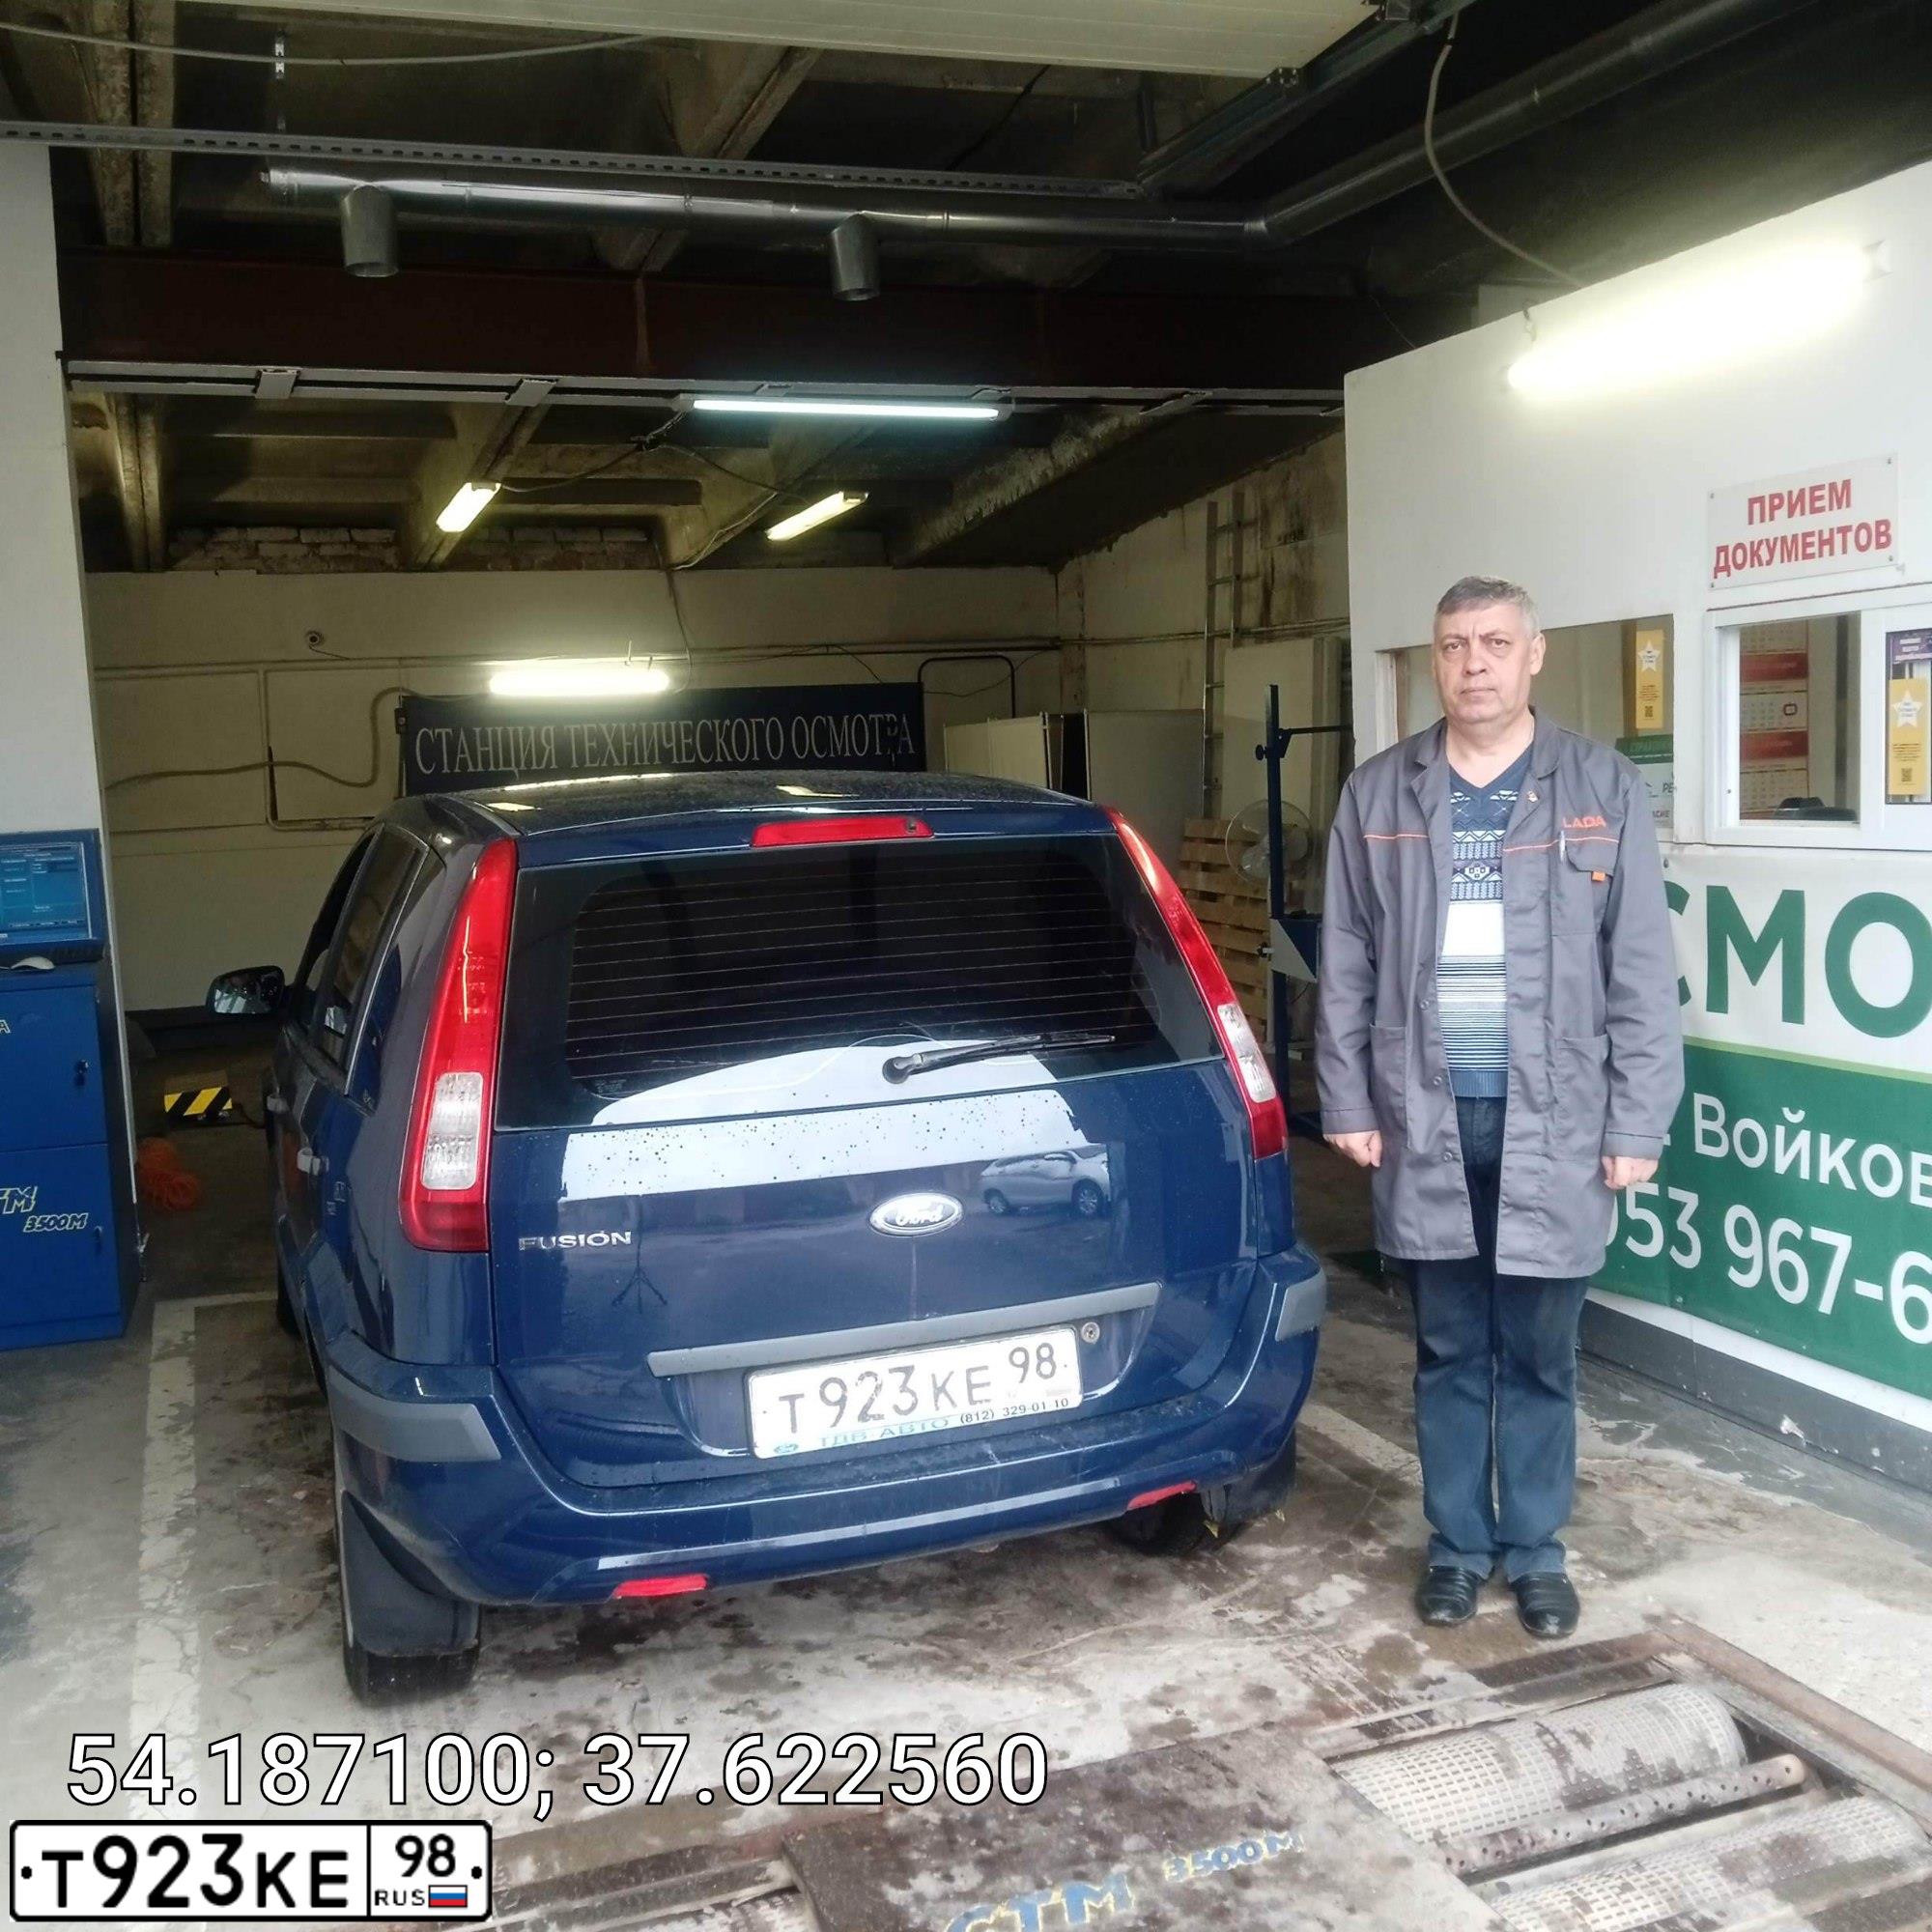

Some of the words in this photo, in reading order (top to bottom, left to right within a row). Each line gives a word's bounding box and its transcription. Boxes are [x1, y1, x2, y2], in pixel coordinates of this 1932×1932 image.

[1747, 478, 1852, 526] ПРИЕМ
[1713, 518, 1892, 580] ДОКУМЕНТОВ
[414, 725, 558, 779] СТАНЦИЯ
[564, 717, 784, 768] ТЕХНИЧЕСКОГО
[1562, 815, 1606, 828] LADA
[1663, 880, 1932, 1038] МО
[518, 1231, 633, 1251] FUSION
[959, 1408, 996, 1425] (812)
